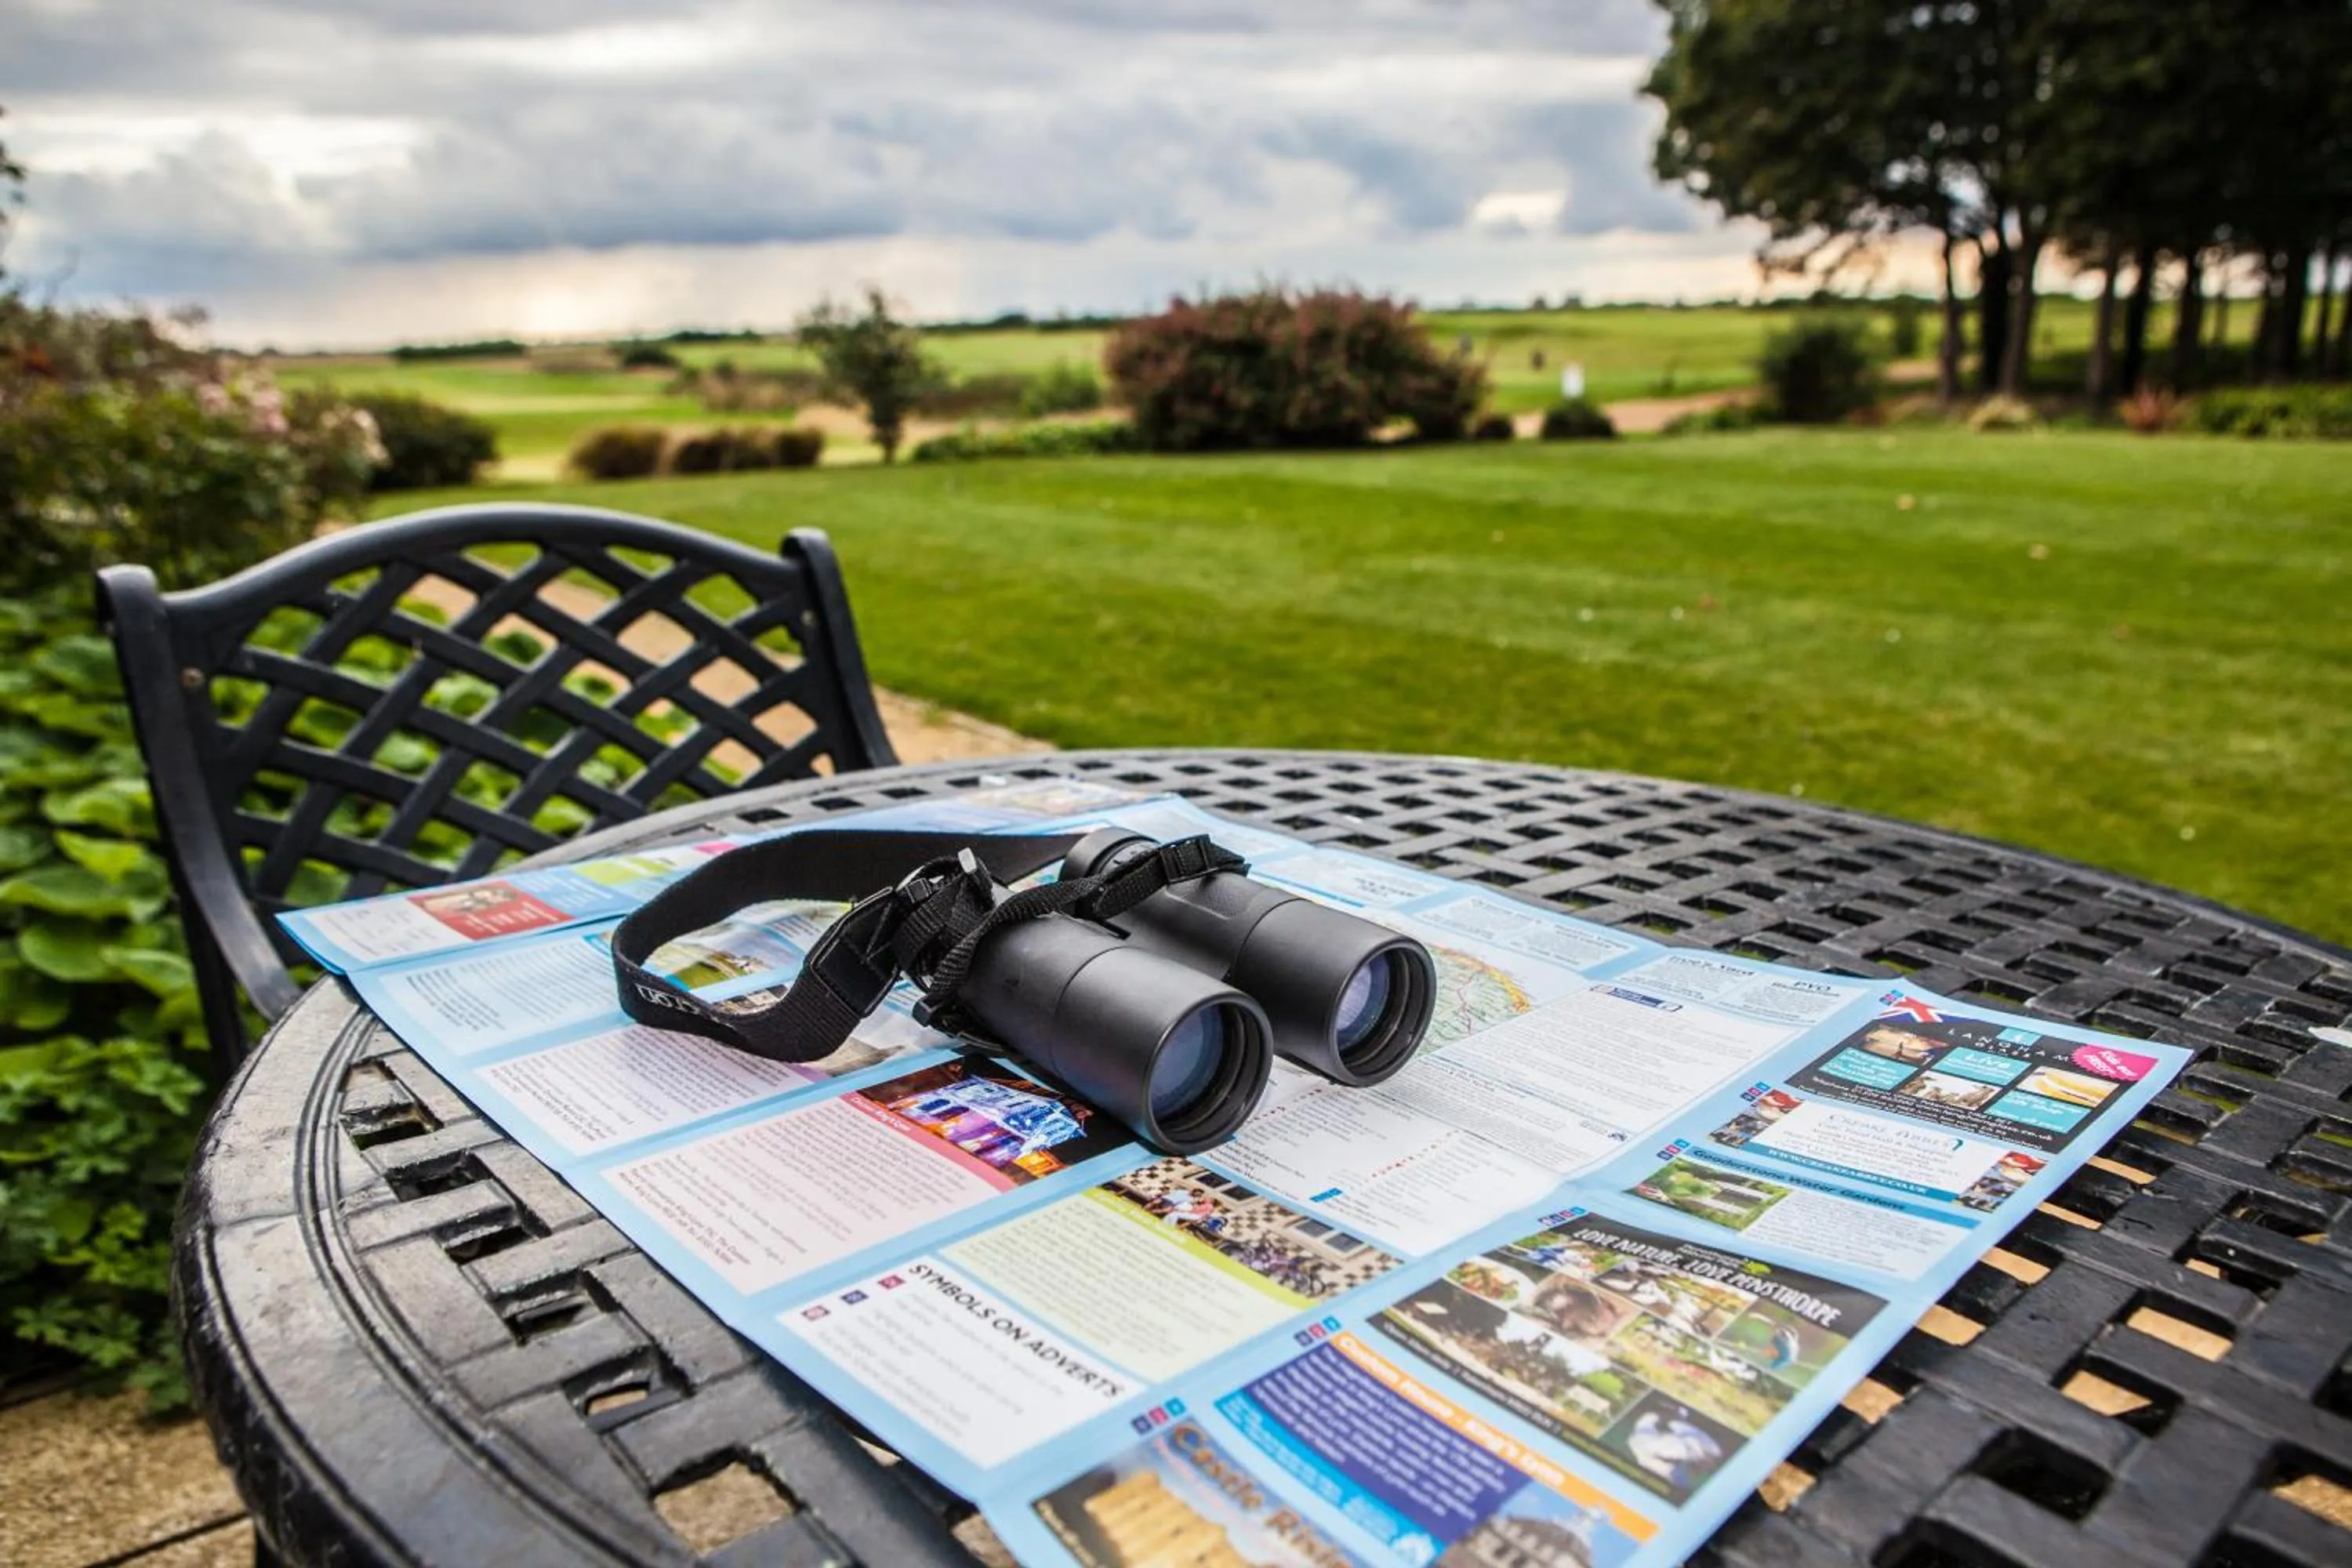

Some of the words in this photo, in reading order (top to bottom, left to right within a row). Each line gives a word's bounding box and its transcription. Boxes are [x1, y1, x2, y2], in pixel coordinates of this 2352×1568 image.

[1693, 1149, 1786, 1181] Gooderstone
[1788, 1174, 1836, 1195] Water
[1840, 1188, 1906, 1211] Gardens
[1573, 1228, 1619, 1250] LOVE
[1683, 1258, 1735, 1283] LOVE
[1728, 1272, 1842, 1327] PENSTHORPE
[909, 1262, 997, 1320] SYMBOLS
[992, 1315, 1029, 1343] ON
[1026, 1337, 1126, 1399] ADVERTS
